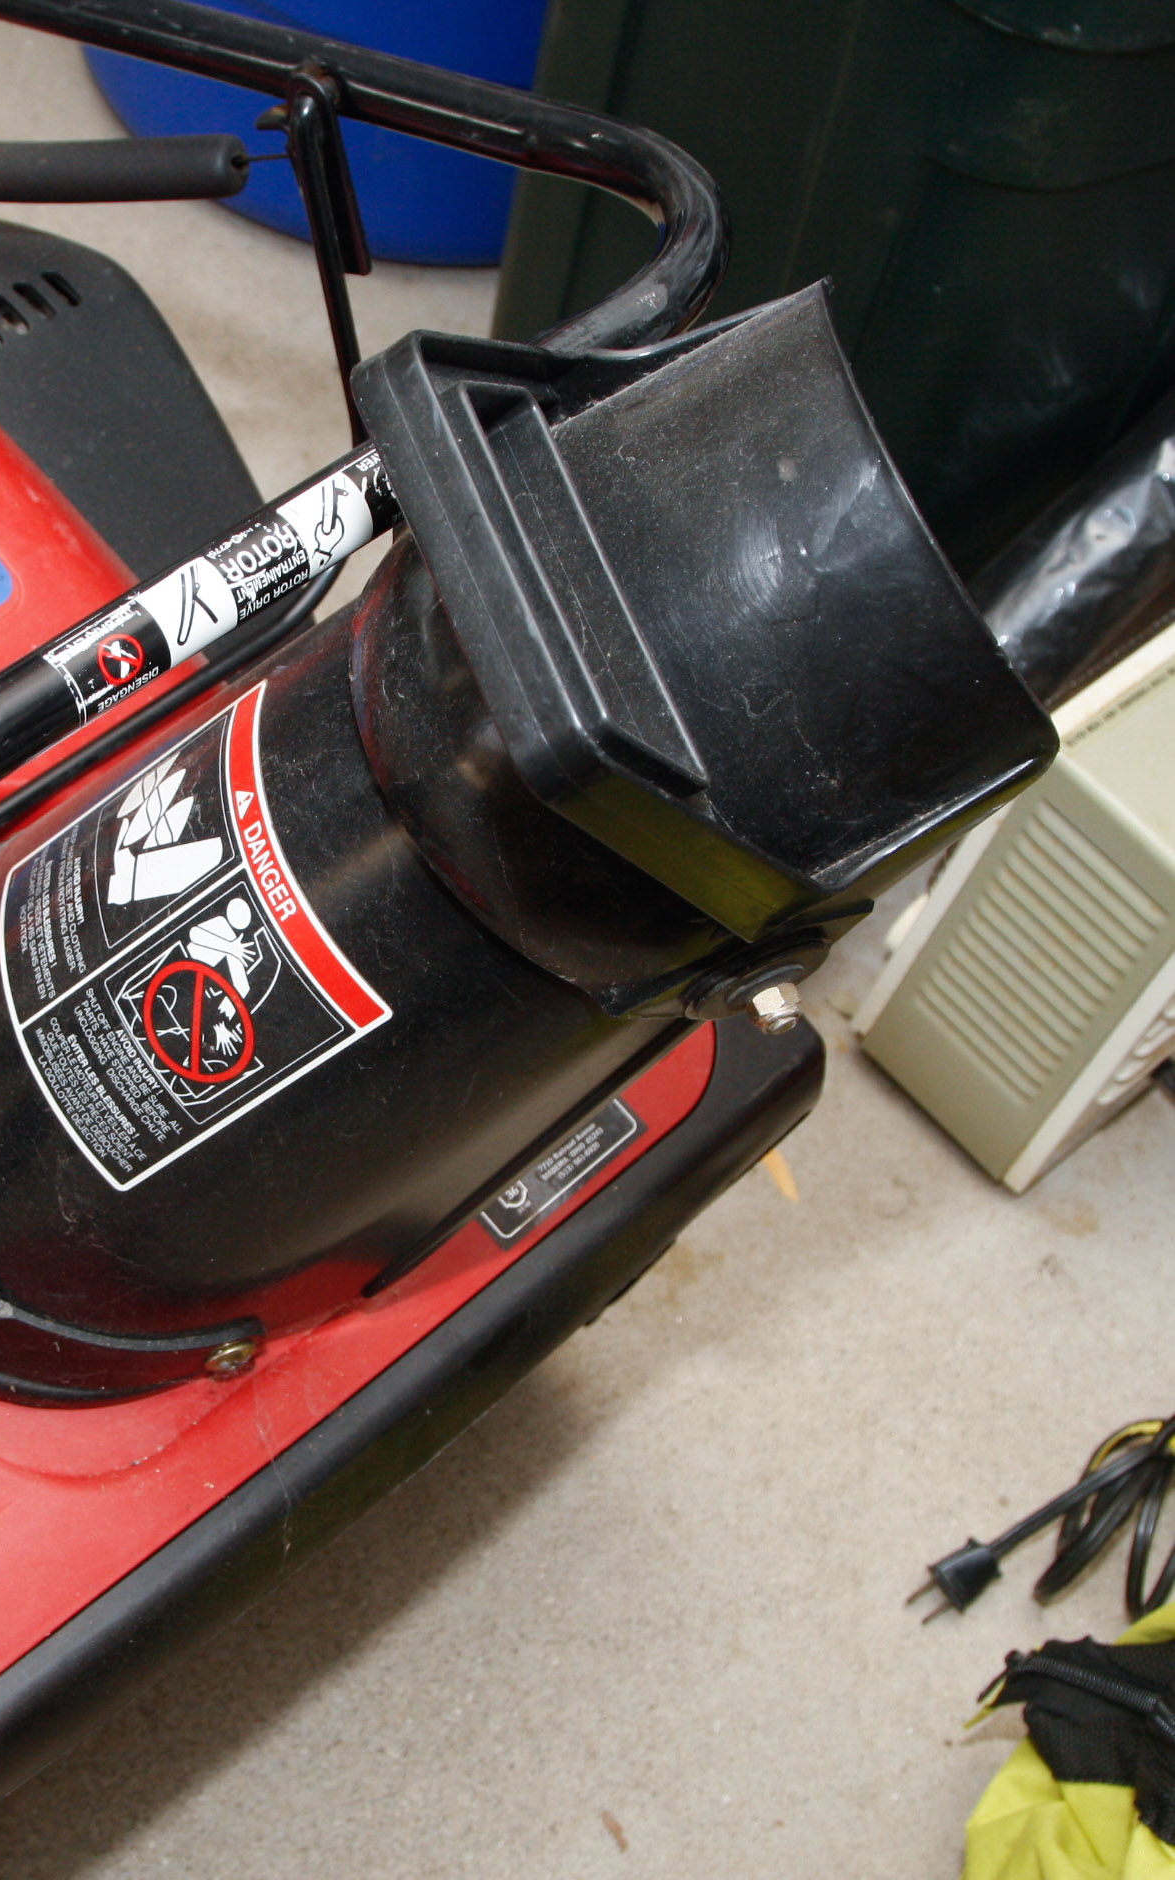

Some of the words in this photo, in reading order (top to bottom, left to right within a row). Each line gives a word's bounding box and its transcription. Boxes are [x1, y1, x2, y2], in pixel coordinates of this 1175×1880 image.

[219, 524, 297, 585] ROTOR
[273, 568, 312, 598] ROTOR
[236, 592, 271, 620] DRIVE
[97, 666, 159, 713] DISENGAGE
[57, 859, 66, 888] FROM
[65, 876, 73, 901] FEET
[73, 856, 81, 887] AVOID
[243, 820, 297, 922] DANGER
[27, 896, 35, 912] DE
[34, 897, 42, 926] PIEDS
[42, 889, 50, 907] LES
[58, 887, 68, 935] ROTATING
[66, 902, 75, 923] AND
[27, 923, 36, 940] VIS
[35, 925, 44, 939] ET
[42, 906, 57, 963] BLESSURES
[69, 922, 87, 974] CLOTHING
[28, 939, 39, 967] SANS
[33, 966, 43, 984] FIN
[37, 983, 47, 1000] EN
[74, 1005, 108, 1065] UNCLOGGING
[106, 1067, 144, 1116] DISCHARGE
[81, 1000, 100, 1031] PARTS
[97, 1033, 116, 1060] HAVE
[111, 1058, 142, 1098] STOPPED
[141, 1100, 171, 1133] BEFORE
[85, 987, 102, 1012] SHUT
[96, 1012, 111, 1031] OFF
[106, 1031, 130, 1066] ENGINE
[125, 1065, 142, 1084] AND
[138, 1082, 152, 1096] BE
[147, 1094, 170, 1118] SURE
[168, 1120, 183, 1135] ALL
[112, 1029, 137, 1058] AVOID
[133, 1057, 160, 1090] INJURY
[37, 1054, 48, 1069] LA
[44, 1067, 75, 1114] GOULOTTE
[43, 1031, 60, 1053] QUE
[56, 1051, 79, 1088] TOUTES
[74, 1086, 90, 1105] LES
[107, 1132, 134, 1159] SOIENT
[49, 1017, 71, 1055] COUPER
[66, 1053, 78, 1066] LE
[73, 1064, 99, 1102] MOTEUR
[94, 1100, 108, 1112] ET
[104, 1111, 131, 1144] VEILLER
[133, 1148, 147, 1161] CE
[84, 1066, 100, 1086] LES
[95, 1084, 136, 1135] BLESSURES
[63, 1086, 86, 1113] AVANT
[81, 1112, 94, 1126] DE
